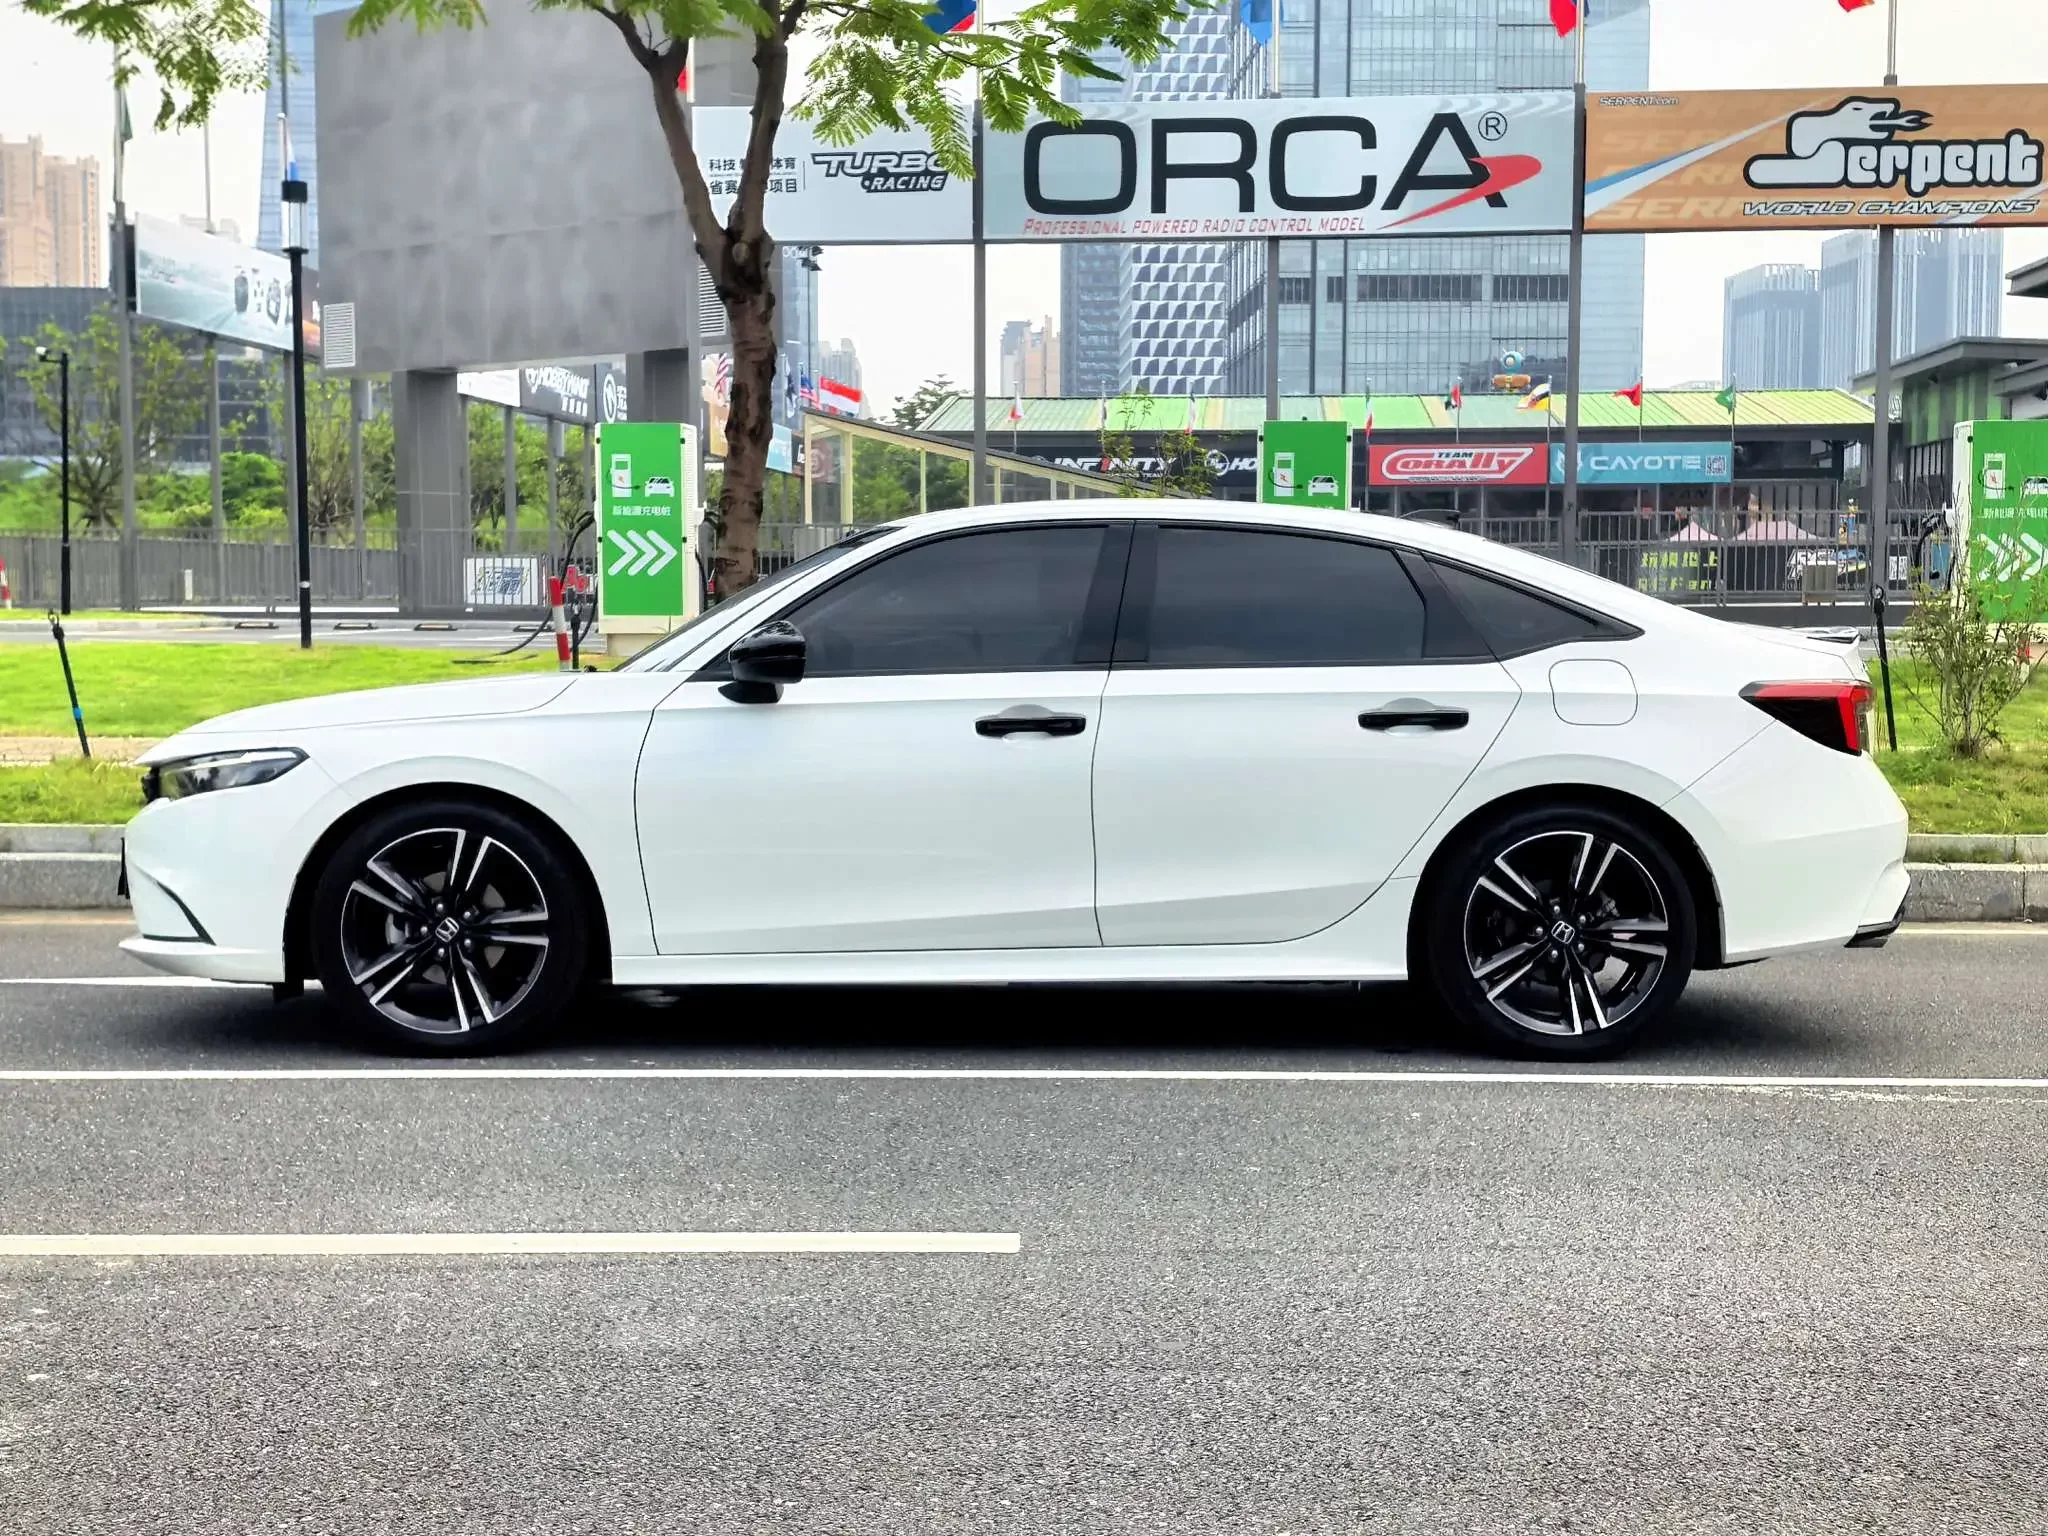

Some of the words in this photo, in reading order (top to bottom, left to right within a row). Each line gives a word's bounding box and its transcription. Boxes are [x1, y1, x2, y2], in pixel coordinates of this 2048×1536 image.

[1743, 96, 2044, 198] Serpent
[1023, 112, 1508, 216] ORCA
[869, 175, 947, 191] RACING
[1743, 201, 1855, 216] WORLD
[1857, 199, 2040, 215] CHAMPIONS
[1023, 218, 1127, 235] PROFESSIONAL
[1132, 218, 1198, 234] POWERED
[1202, 217, 1245, 233] RADIO
[1249, 217, 1313, 232] CONTROL
[1318, 216, 1366, 232] MODEL
[1590, 455, 1702, 471] CAYOTE
